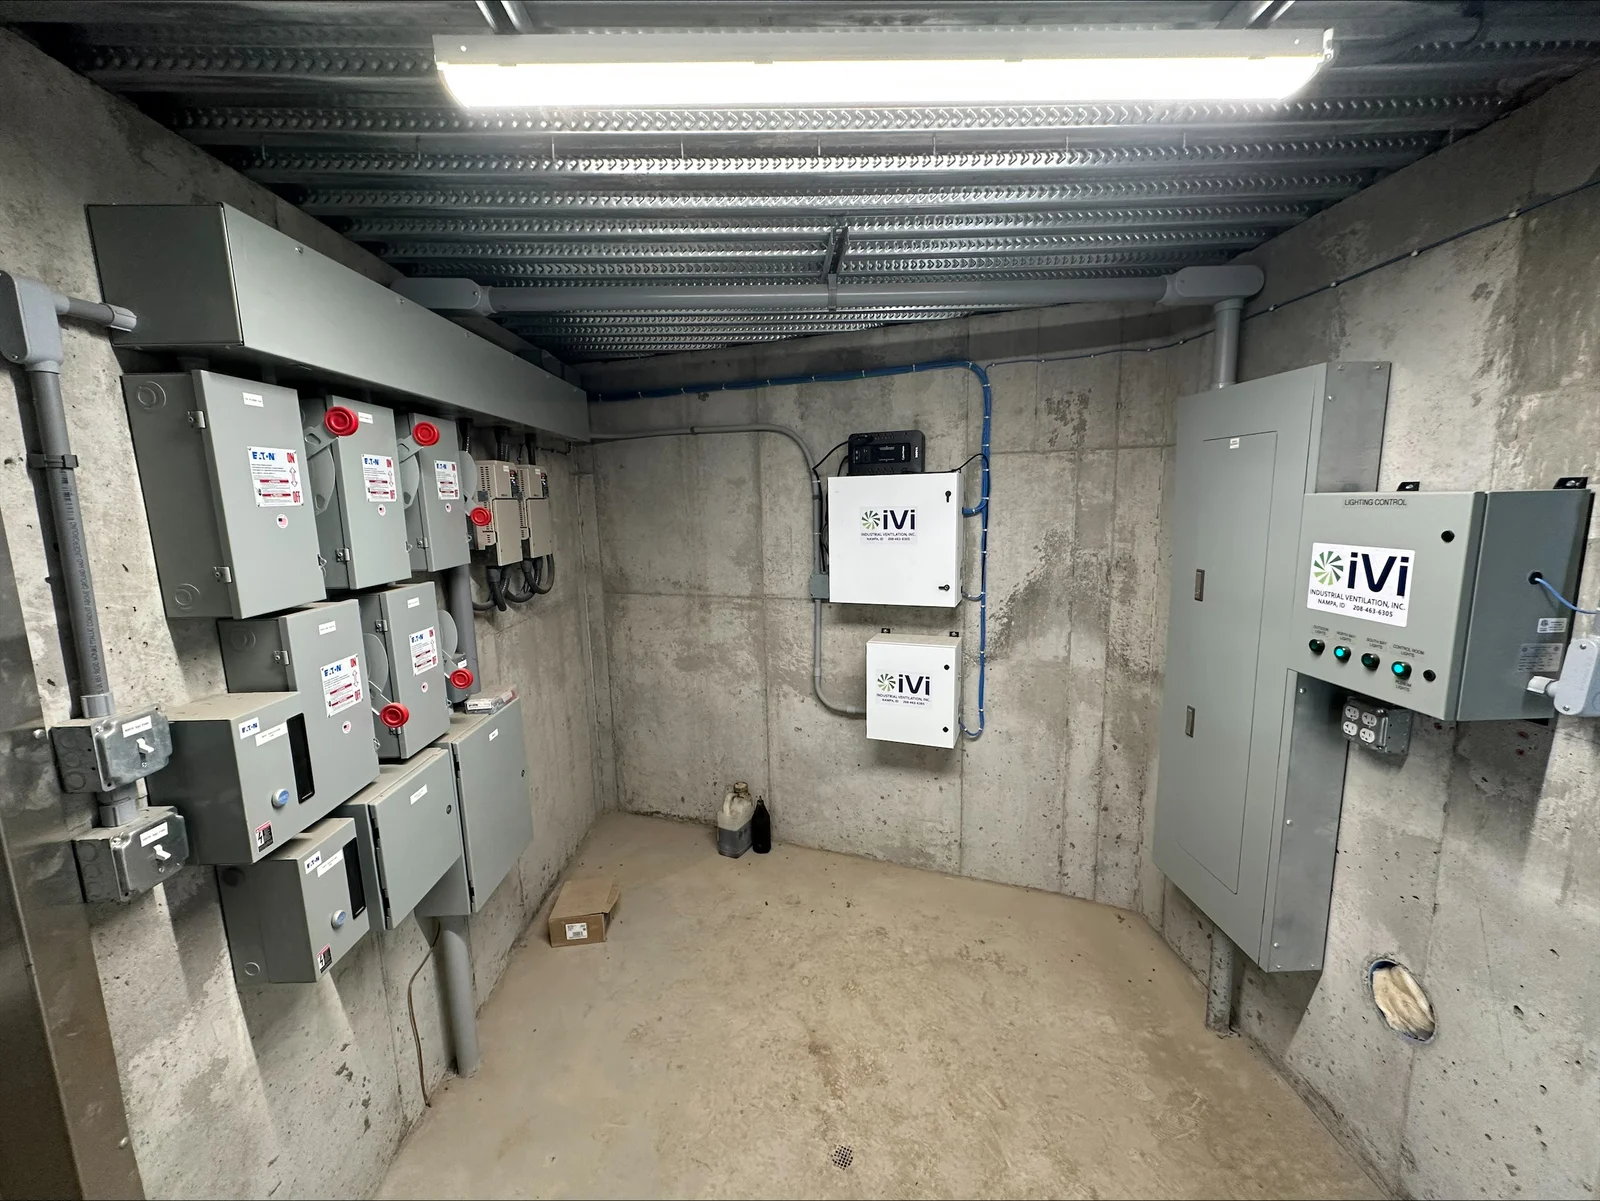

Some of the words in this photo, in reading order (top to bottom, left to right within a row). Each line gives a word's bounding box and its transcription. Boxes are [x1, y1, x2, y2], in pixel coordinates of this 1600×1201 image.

[1344, 498, 1374, 506] LIGHTING
[1374, 498, 1407, 506] CONTROL
[1309, 588, 1344, 601] INDUSTRIAL
[1344, 594, 1390, 609] VENTILATION,
[1390, 602, 1406, 611] INC.
[1317, 598, 1339, 608] NAMPA,
[1352, 604, 1394, 618] 208-463-6305
